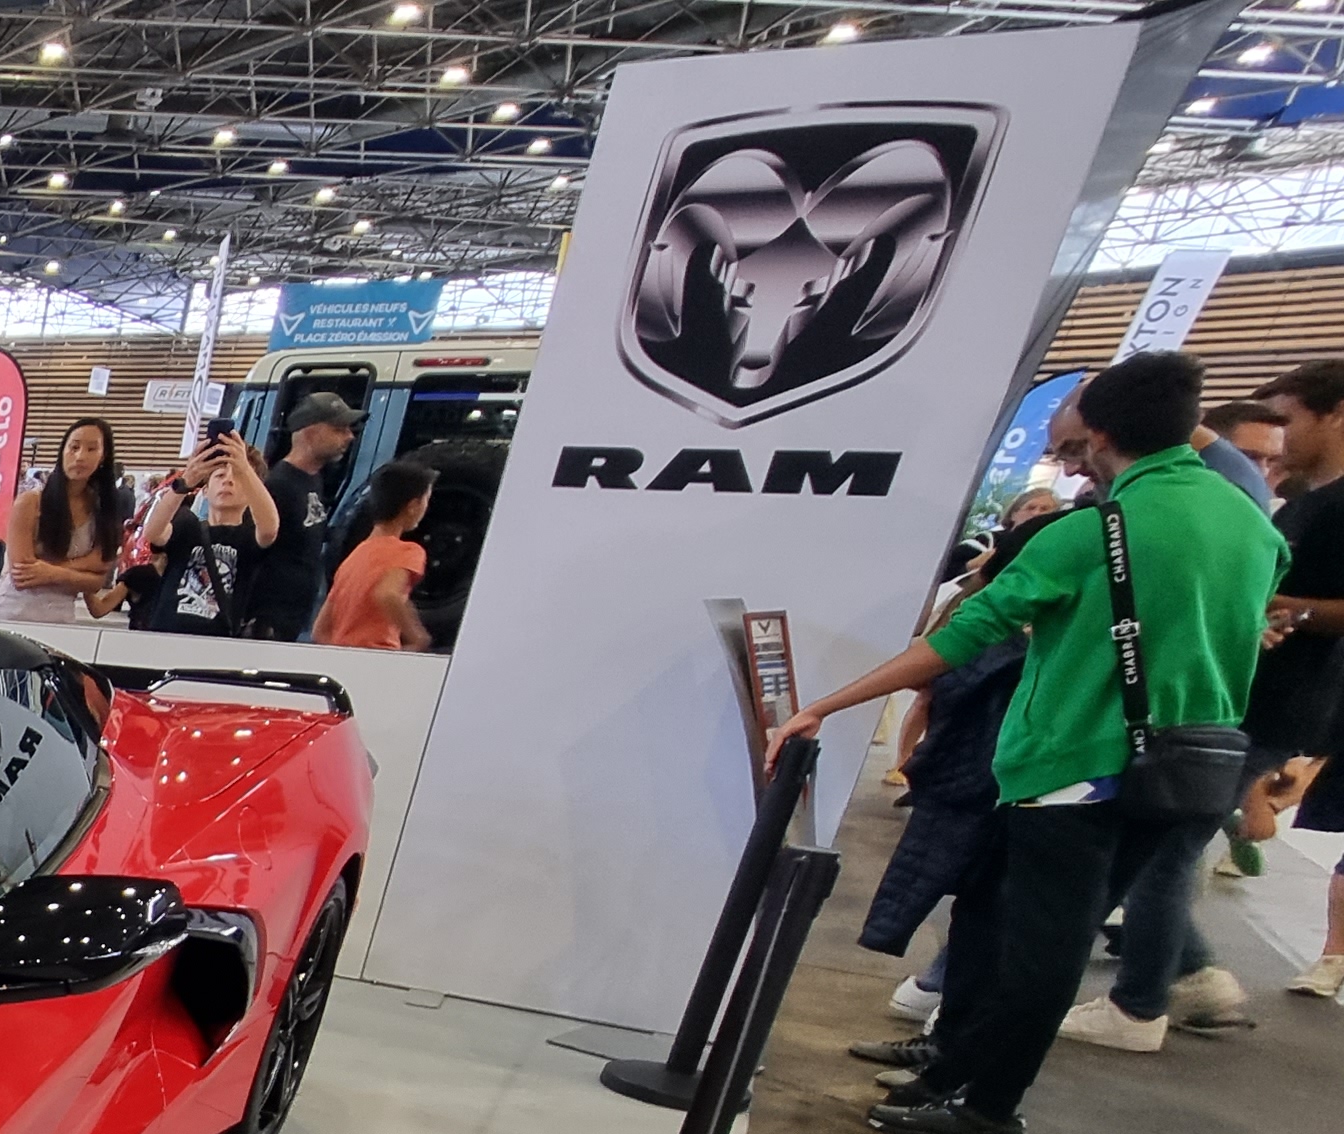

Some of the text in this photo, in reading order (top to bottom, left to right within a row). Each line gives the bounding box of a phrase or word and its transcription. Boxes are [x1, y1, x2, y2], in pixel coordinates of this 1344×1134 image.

[309, 302, 408, 315] VÉHICULES NEUFS
[313, 317, 384, 328] RESTAURANT
[1123, 276, 1186, 358] XTON
[294, 332, 328, 343] PLACE
[328, 330, 357, 342] ZÉRO
[552, 446, 903, 497] RAM
